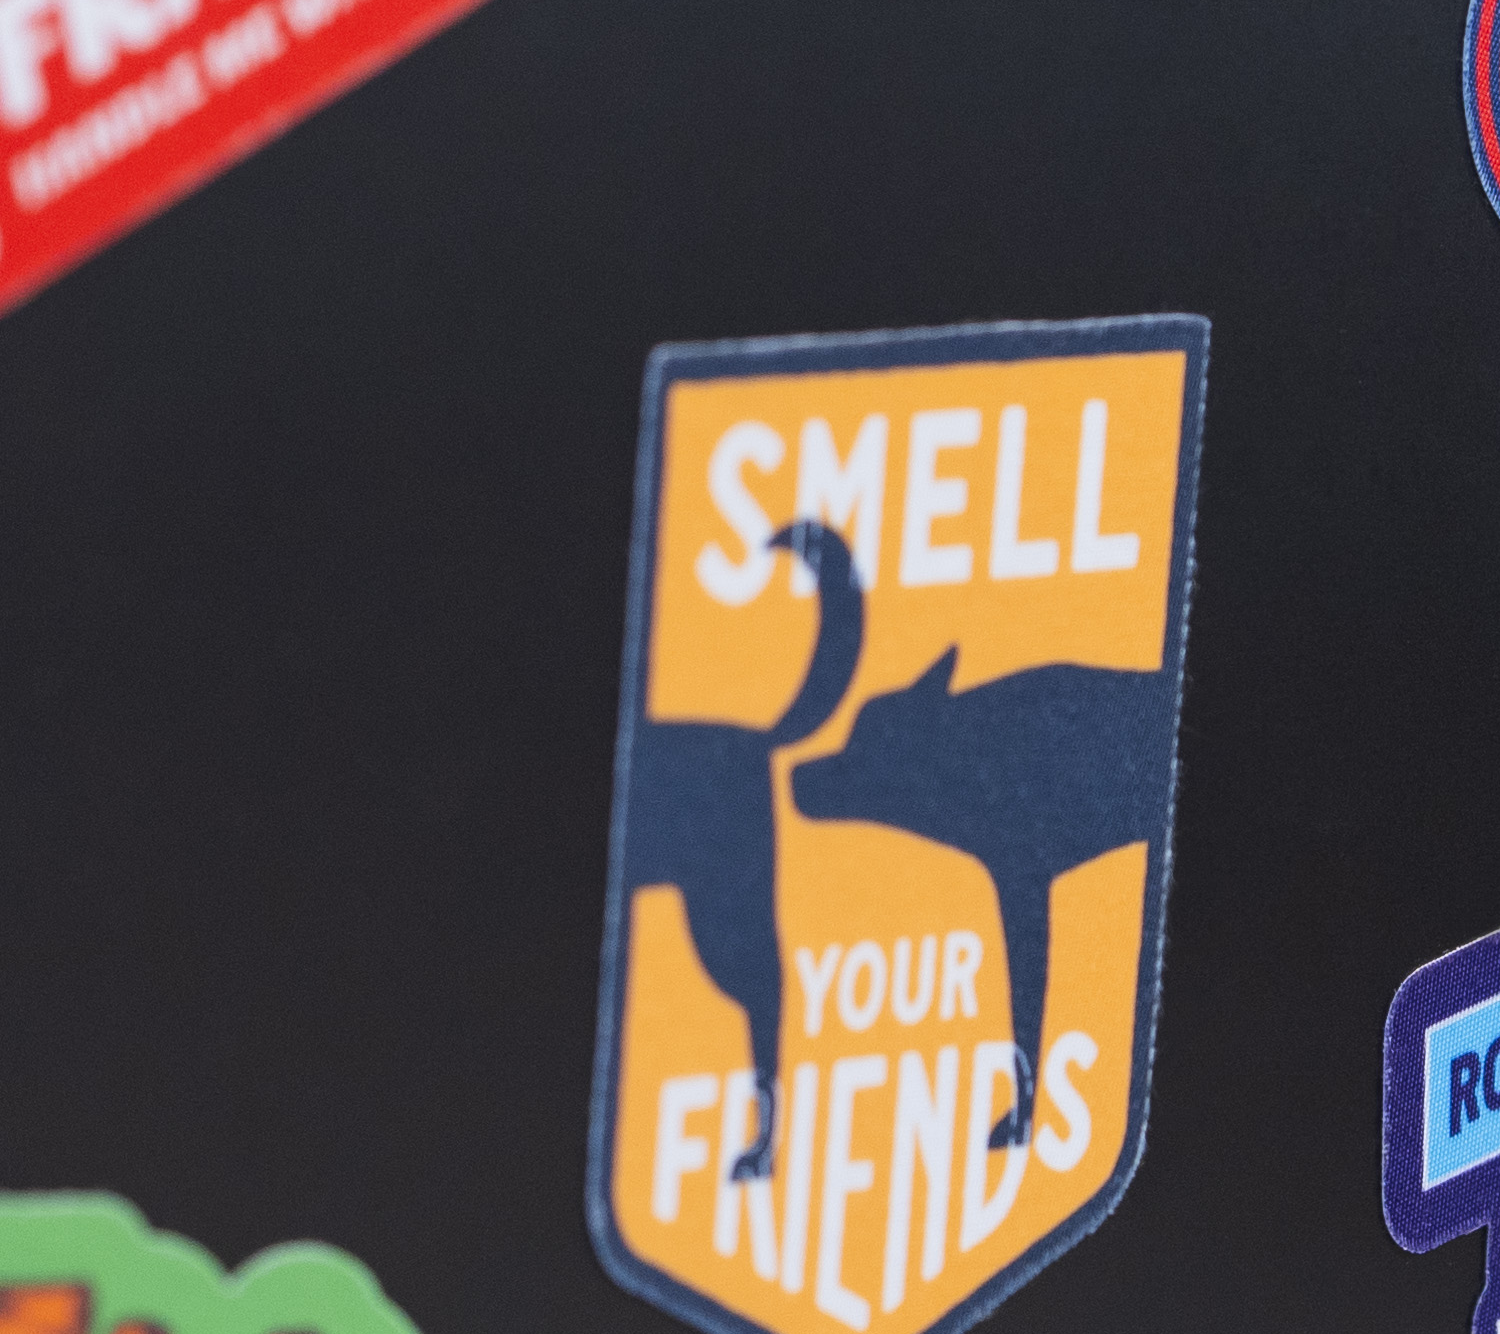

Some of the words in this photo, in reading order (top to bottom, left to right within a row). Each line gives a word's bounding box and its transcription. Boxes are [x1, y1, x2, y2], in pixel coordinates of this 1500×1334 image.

[695, 398, 1140, 606] SMELL
[796, 930, 984, 1037] YOUR
[651, 1029, 1099, 1332] FRIENDS
